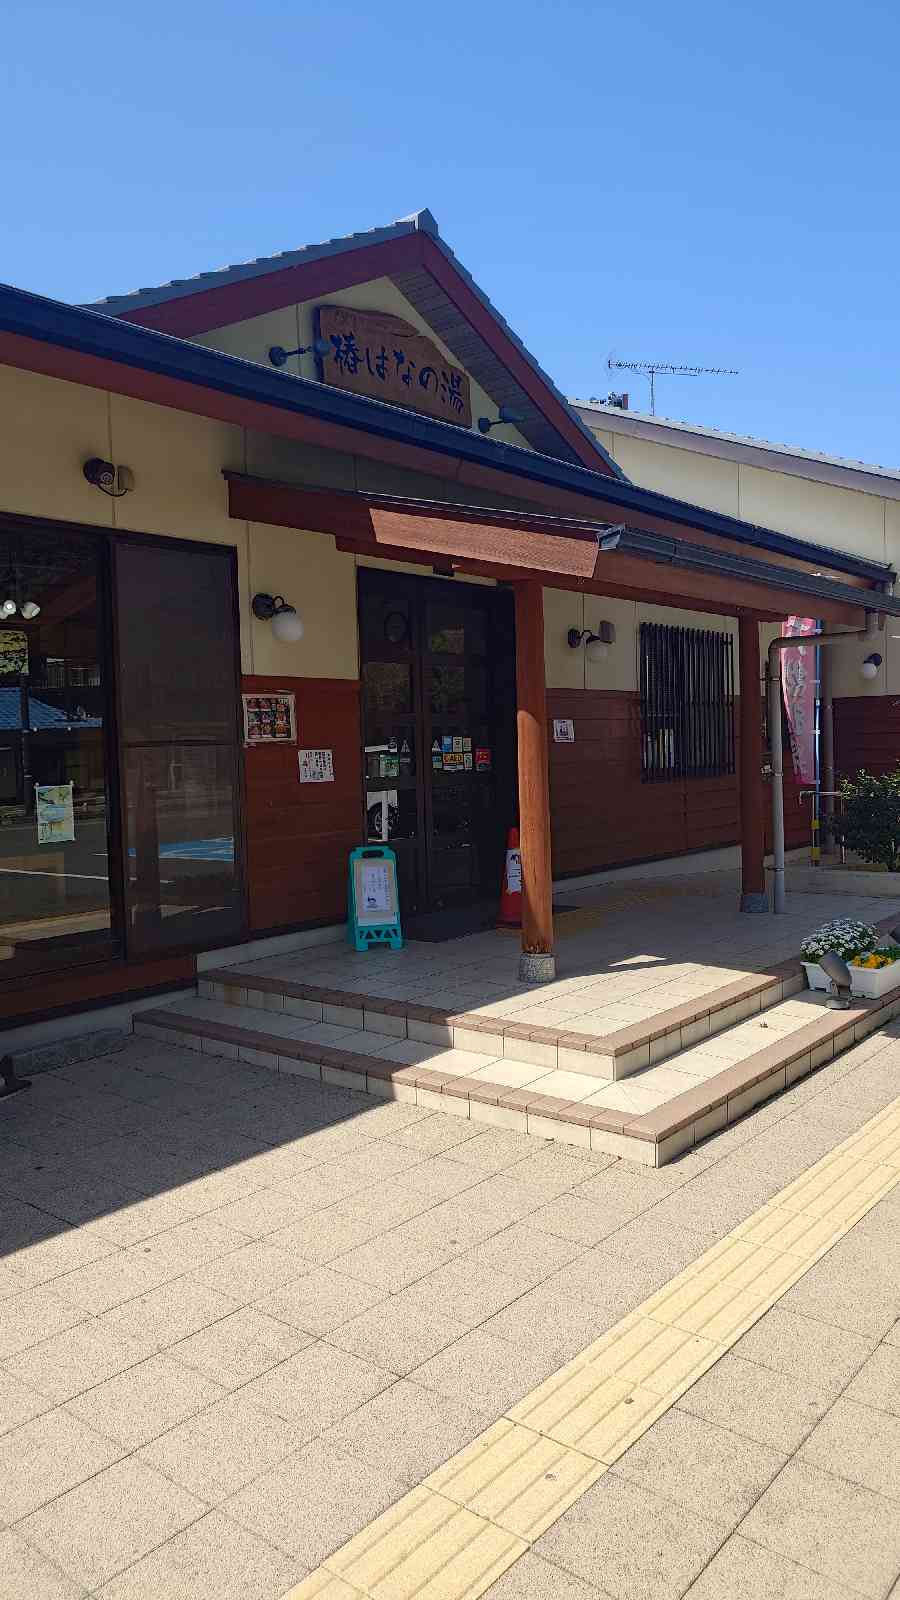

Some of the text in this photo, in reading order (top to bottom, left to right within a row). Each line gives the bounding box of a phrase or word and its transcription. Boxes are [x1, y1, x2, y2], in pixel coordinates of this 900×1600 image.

[330, 332, 464, 414] 椿はなの湯
